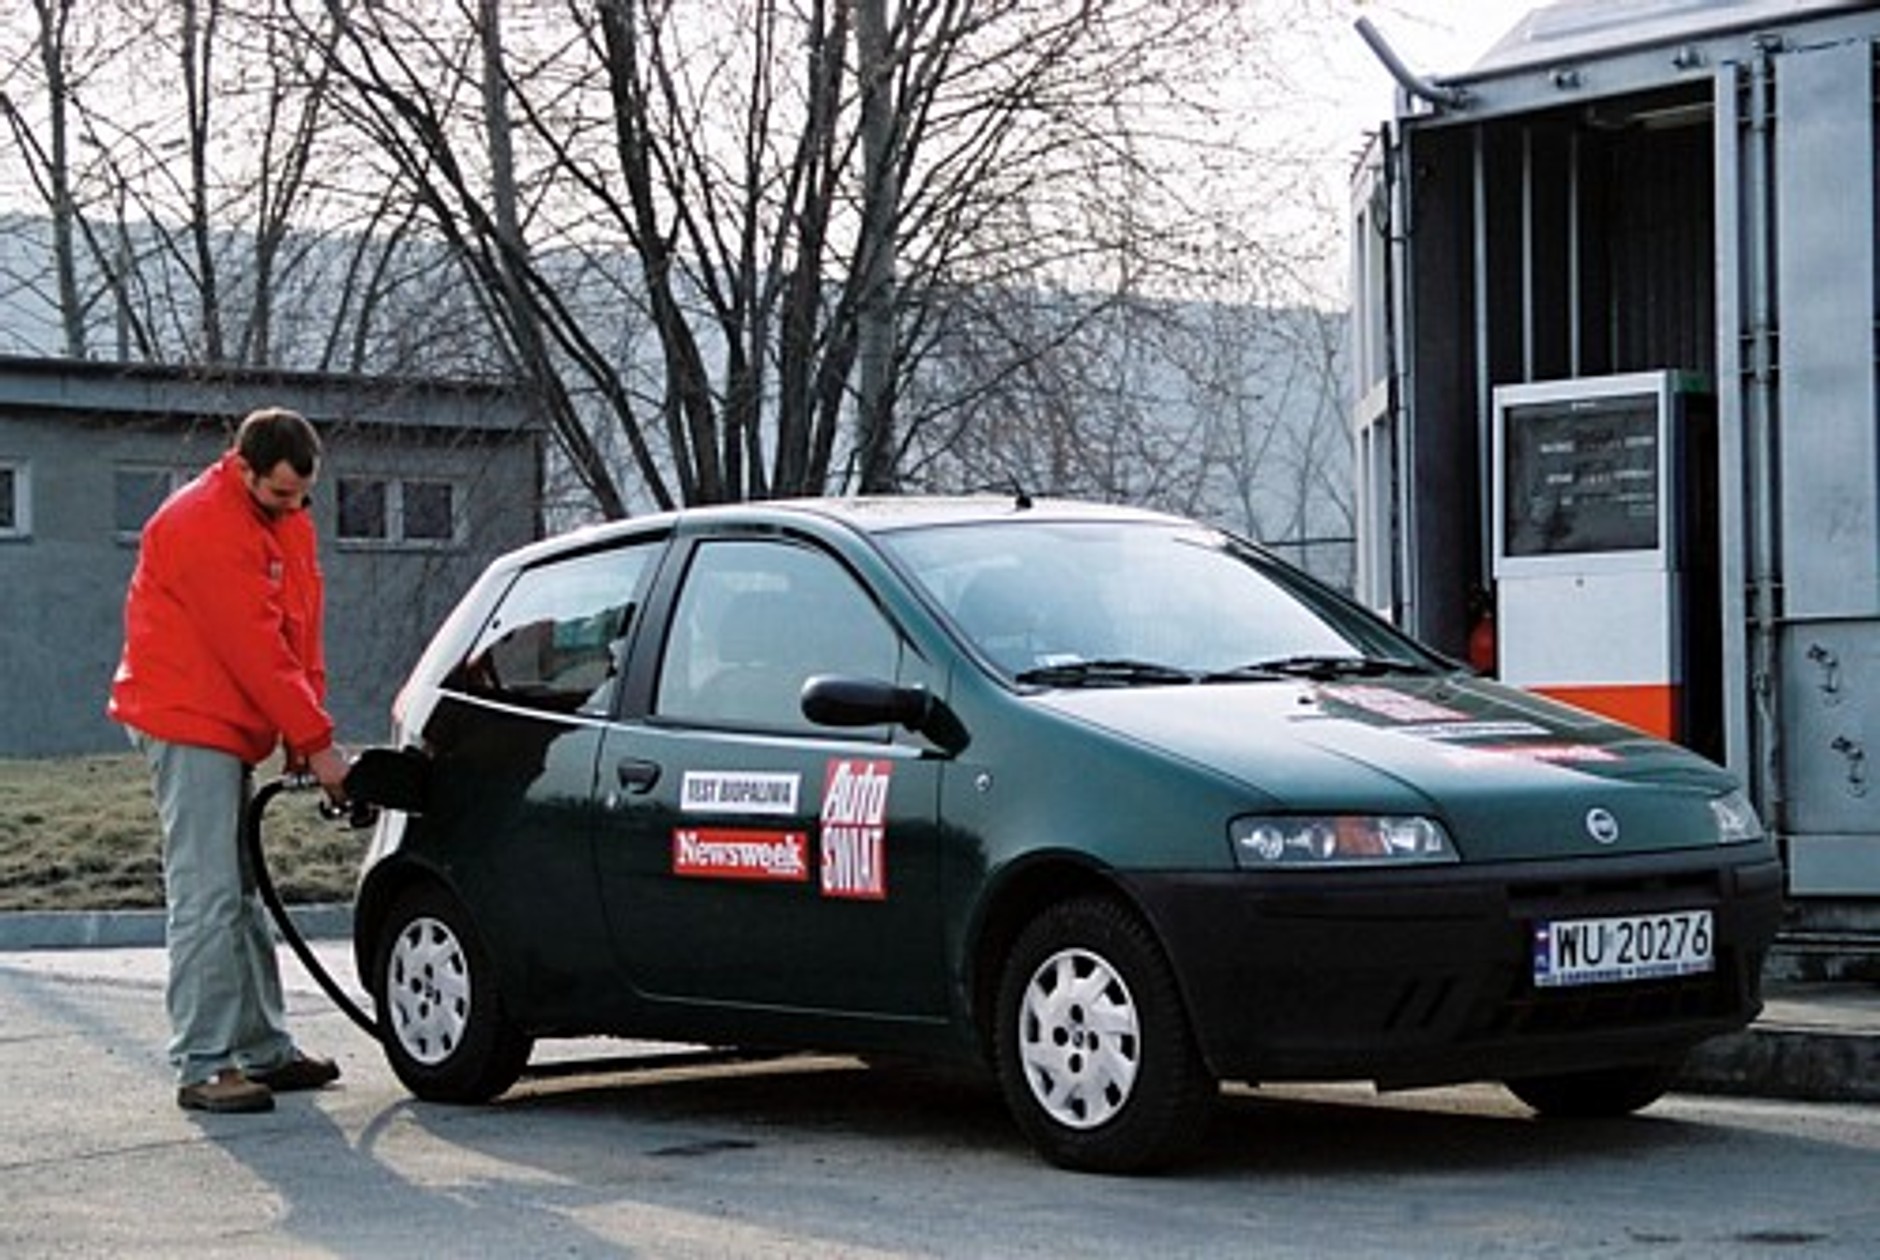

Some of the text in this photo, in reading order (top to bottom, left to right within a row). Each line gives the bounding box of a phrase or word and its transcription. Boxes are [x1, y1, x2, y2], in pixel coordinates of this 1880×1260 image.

[688, 779, 718, 803] TEST
[820, 762, 889, 824] Auto
[677, 831, 806, 871] Newsweek
[1557, 913, 1709, 968] WU 20276
